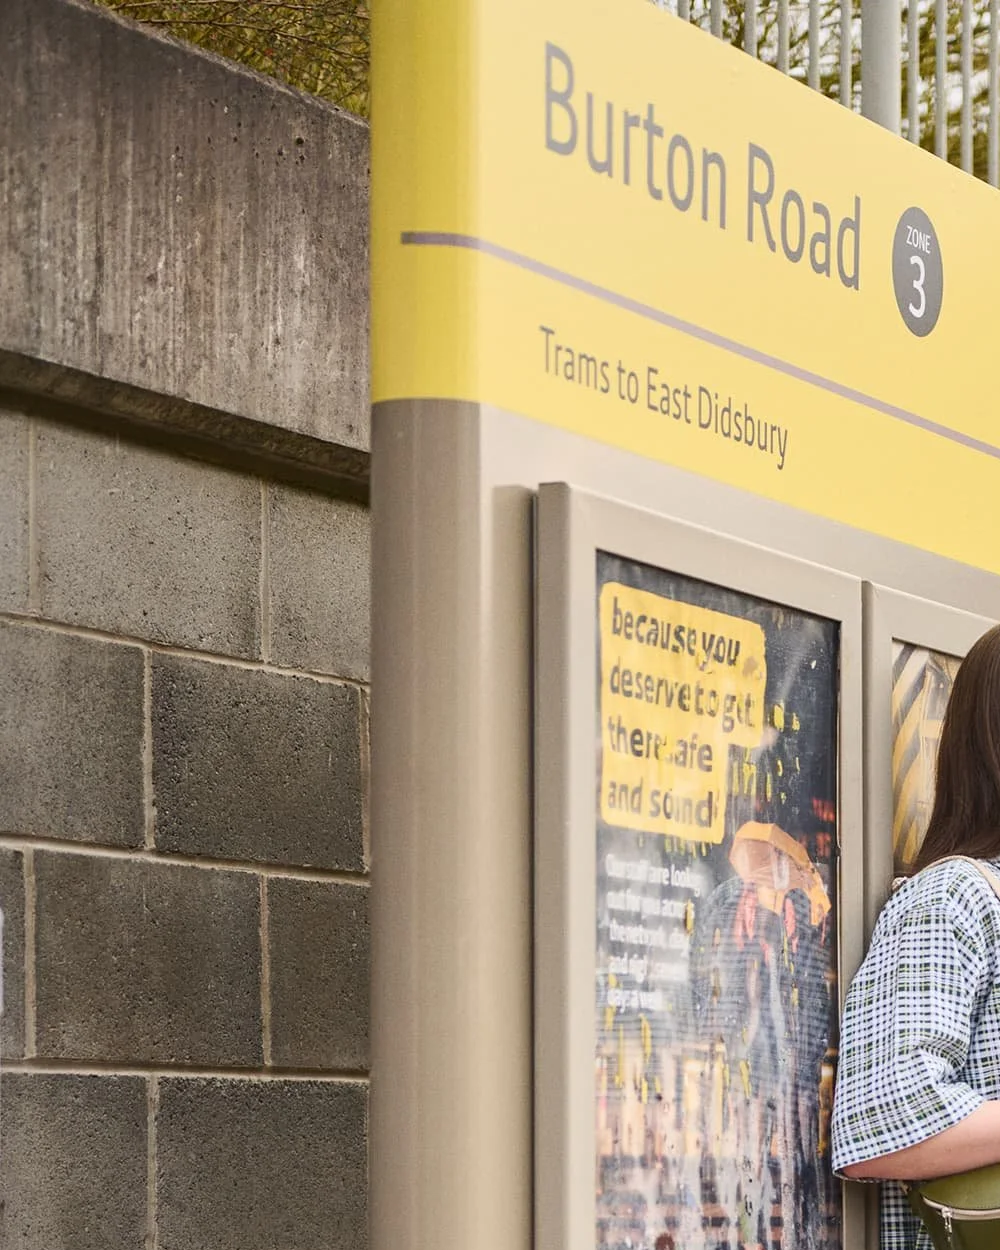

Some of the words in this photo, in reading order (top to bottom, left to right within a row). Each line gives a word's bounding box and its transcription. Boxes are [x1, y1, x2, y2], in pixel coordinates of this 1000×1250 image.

[545, 41, 727, 231] Burton
[747, 142, 861, 292] Road
[906, 225, 931, 256] ZONE
[908, 255, 926, 319] 3
[540, 326, 610, 394] Trams
[617, 359, 640, 405] to
[647, 366, 691, 426] East
[698, 384, 788, 471] Didsbury
[612, 597, 697, 655] because
[701, 631, 740, 672] you
[609, 656, 691, 713] deserve
[607, 777, 643, 815] and
